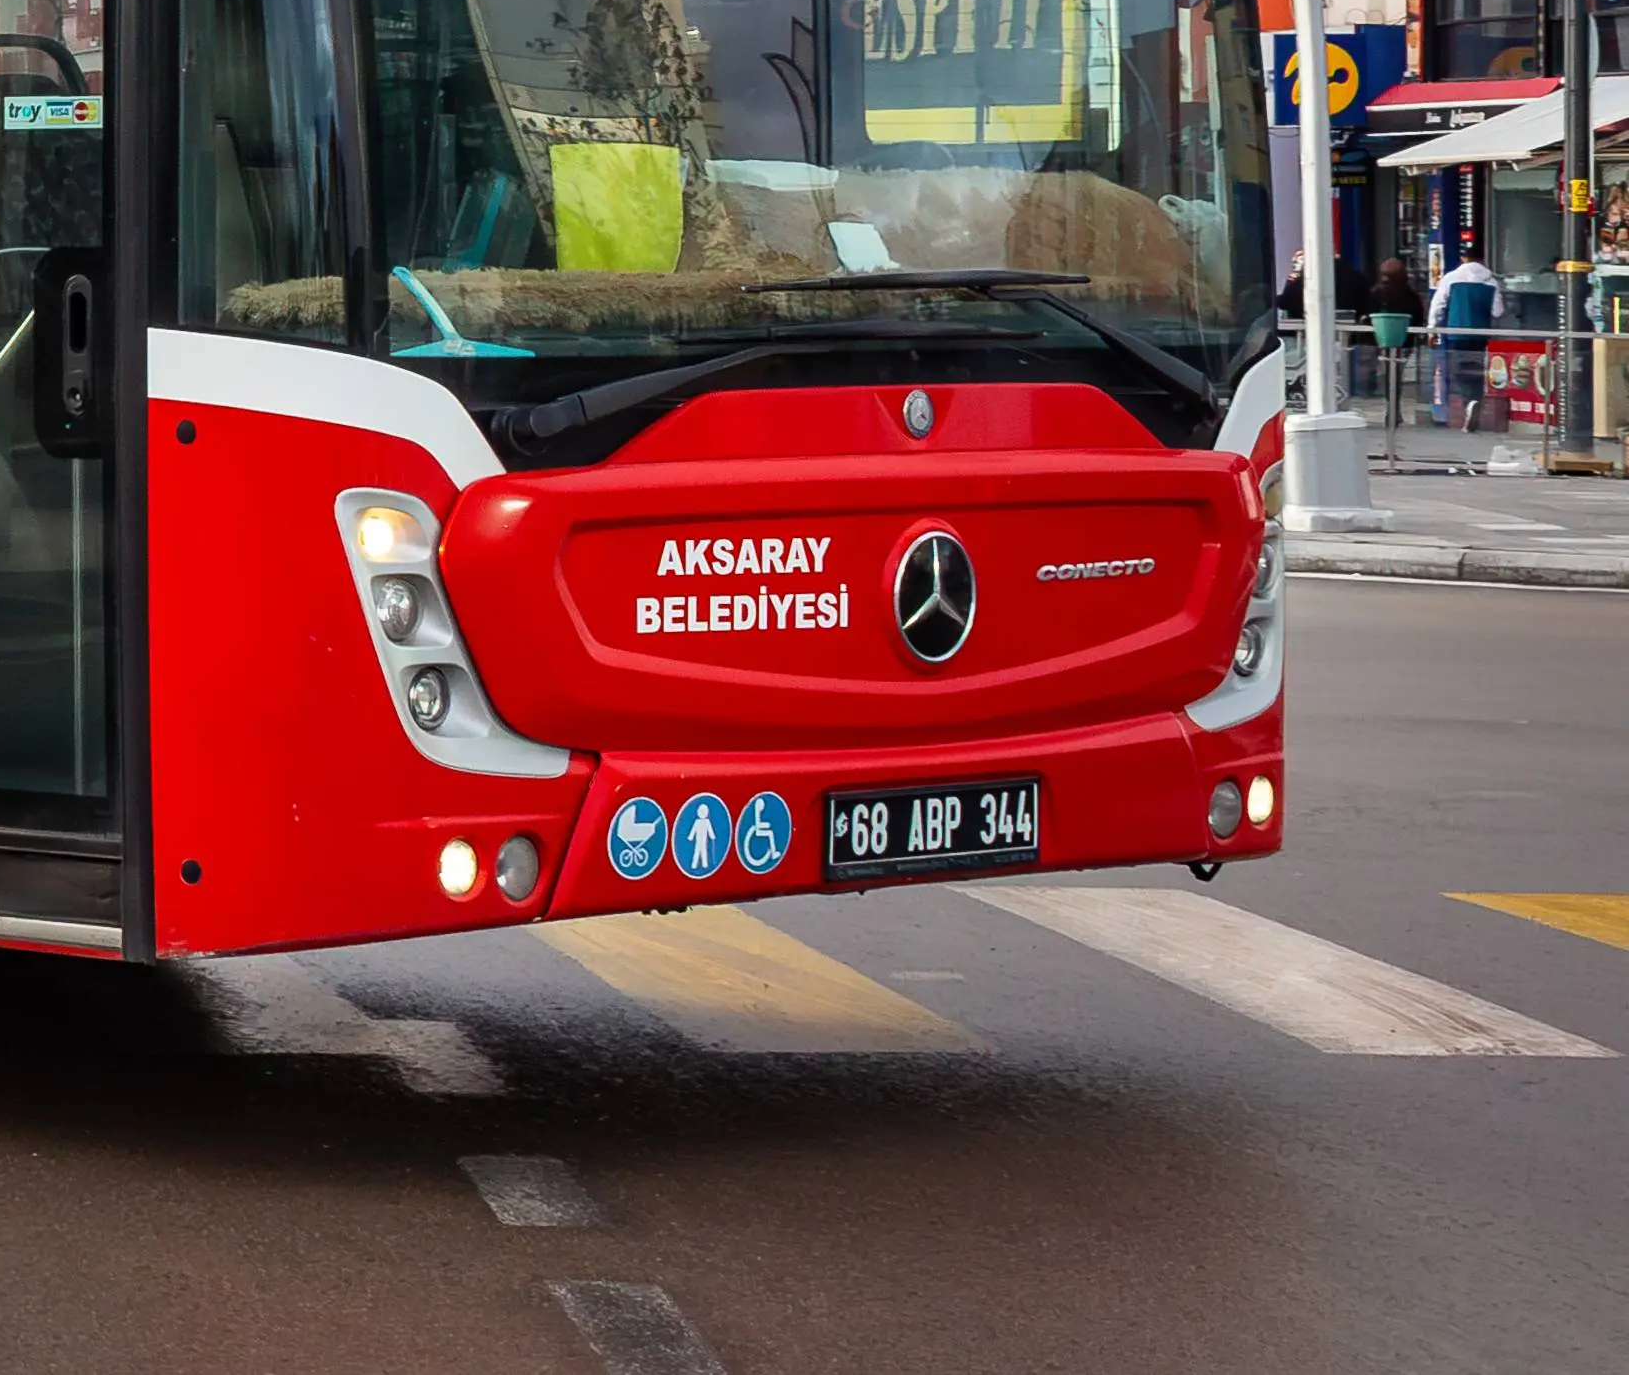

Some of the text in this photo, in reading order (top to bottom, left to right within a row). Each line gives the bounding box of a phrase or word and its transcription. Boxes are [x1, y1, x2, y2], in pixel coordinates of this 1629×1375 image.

[9, 102, 41, 123] troy
[50, 108, 69, 117] VISA
[657, 536, 832, 578] AKSARAY
[1036, 557, 1156, 582] CONECTO
[636, 583, 849, 635] BELEDİYESİ
[851, 790, 1032, 856] 68 ABP 344
